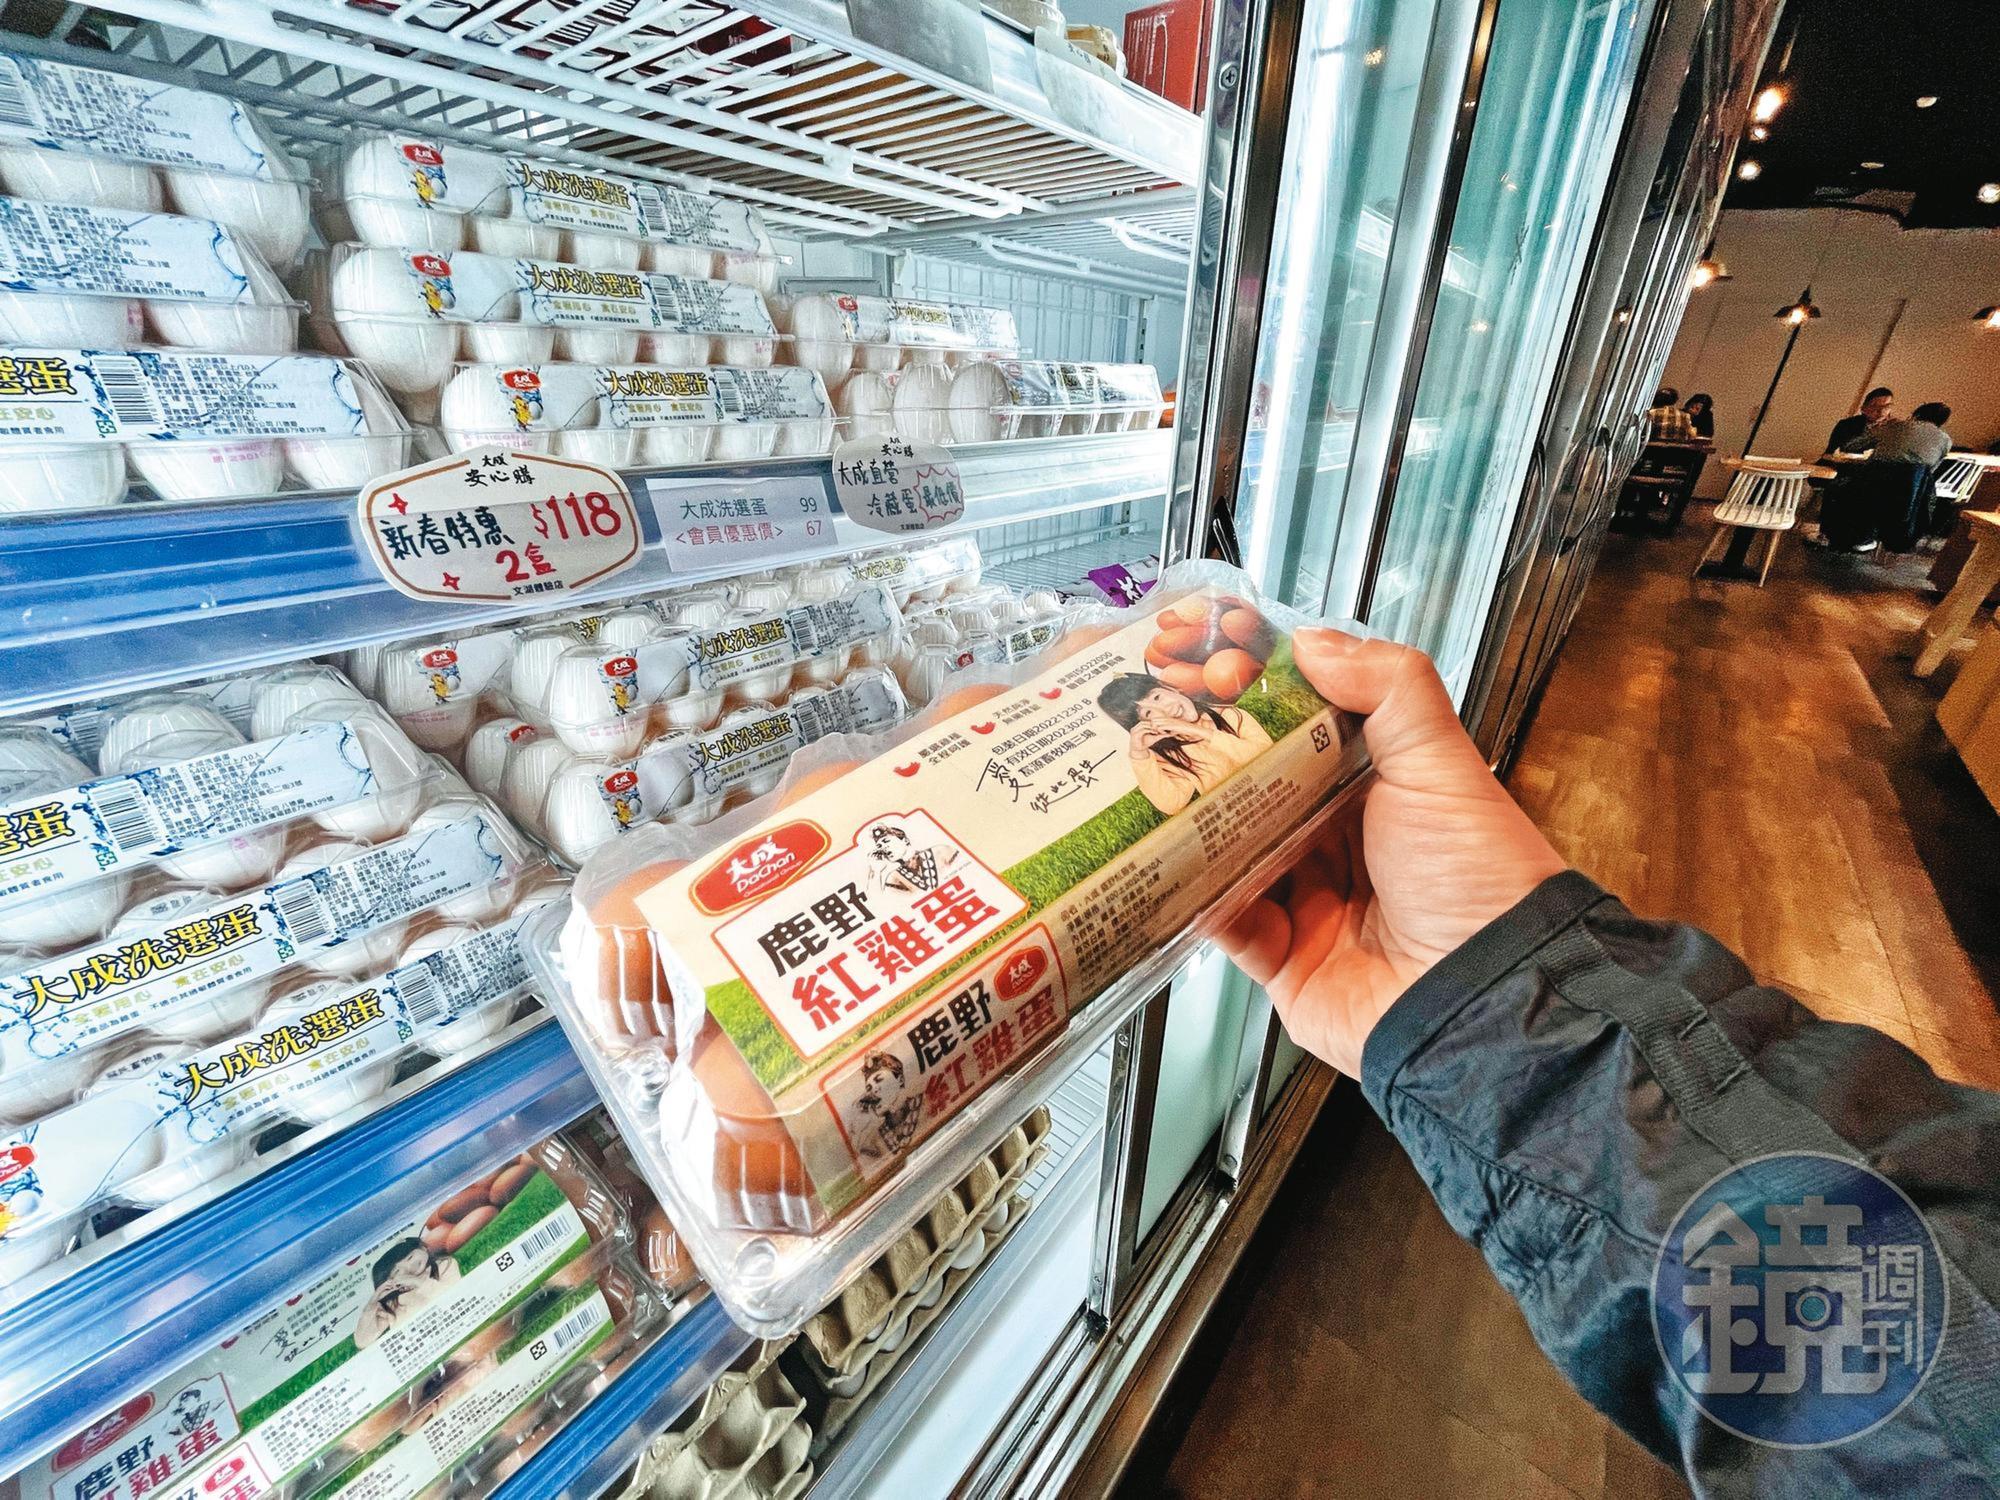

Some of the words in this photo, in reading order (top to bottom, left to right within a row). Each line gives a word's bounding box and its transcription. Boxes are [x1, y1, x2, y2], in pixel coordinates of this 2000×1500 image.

[515, 163, 631, 210] 大成洗選蛋
[526, 264, 645, 299] 大成洗選蛋
[604, 370, 710, 396] 大成洗選蛋
[464, 465, 535, 487] 安心購
[482, 453, 508, 467] 大成
[838, 459, 899, 486] 大成直營
[530, 492, 622, 540] $118
[680, 498, 768, 520] 大成洗選蛋
[800, 497, 818, 512] 99
[806, 520, 822, 537] 67
[380, 505, 515, 560] 新春特惠
[496, 542, 557, 583] 2盒
[513, 580, 564, 596] 文湖體驗店
[695, 618, 787, 661] 大成洗選蛋
[699, 712, 793, 768] 大成洗選蛋
[1004, 711, 1098, 766] 有效日期20230202
[726, 835, 788, 885] 大成
[736, 852, 795, 893] DaChan
[757, 882, 875, 977] 鹿野
[792, 875, 1000, 1031] 紅雞蛋
[15, 904, 262, 1018] 大成洗選蛋
[174, 988, 385, 1105] 大成洗選蛋
[907, 979, 992, 1074] 鹿野
[924, 984, 1058, 1118] 紅雞蛋
[75, 1434, 154, 1500] 鹿野
